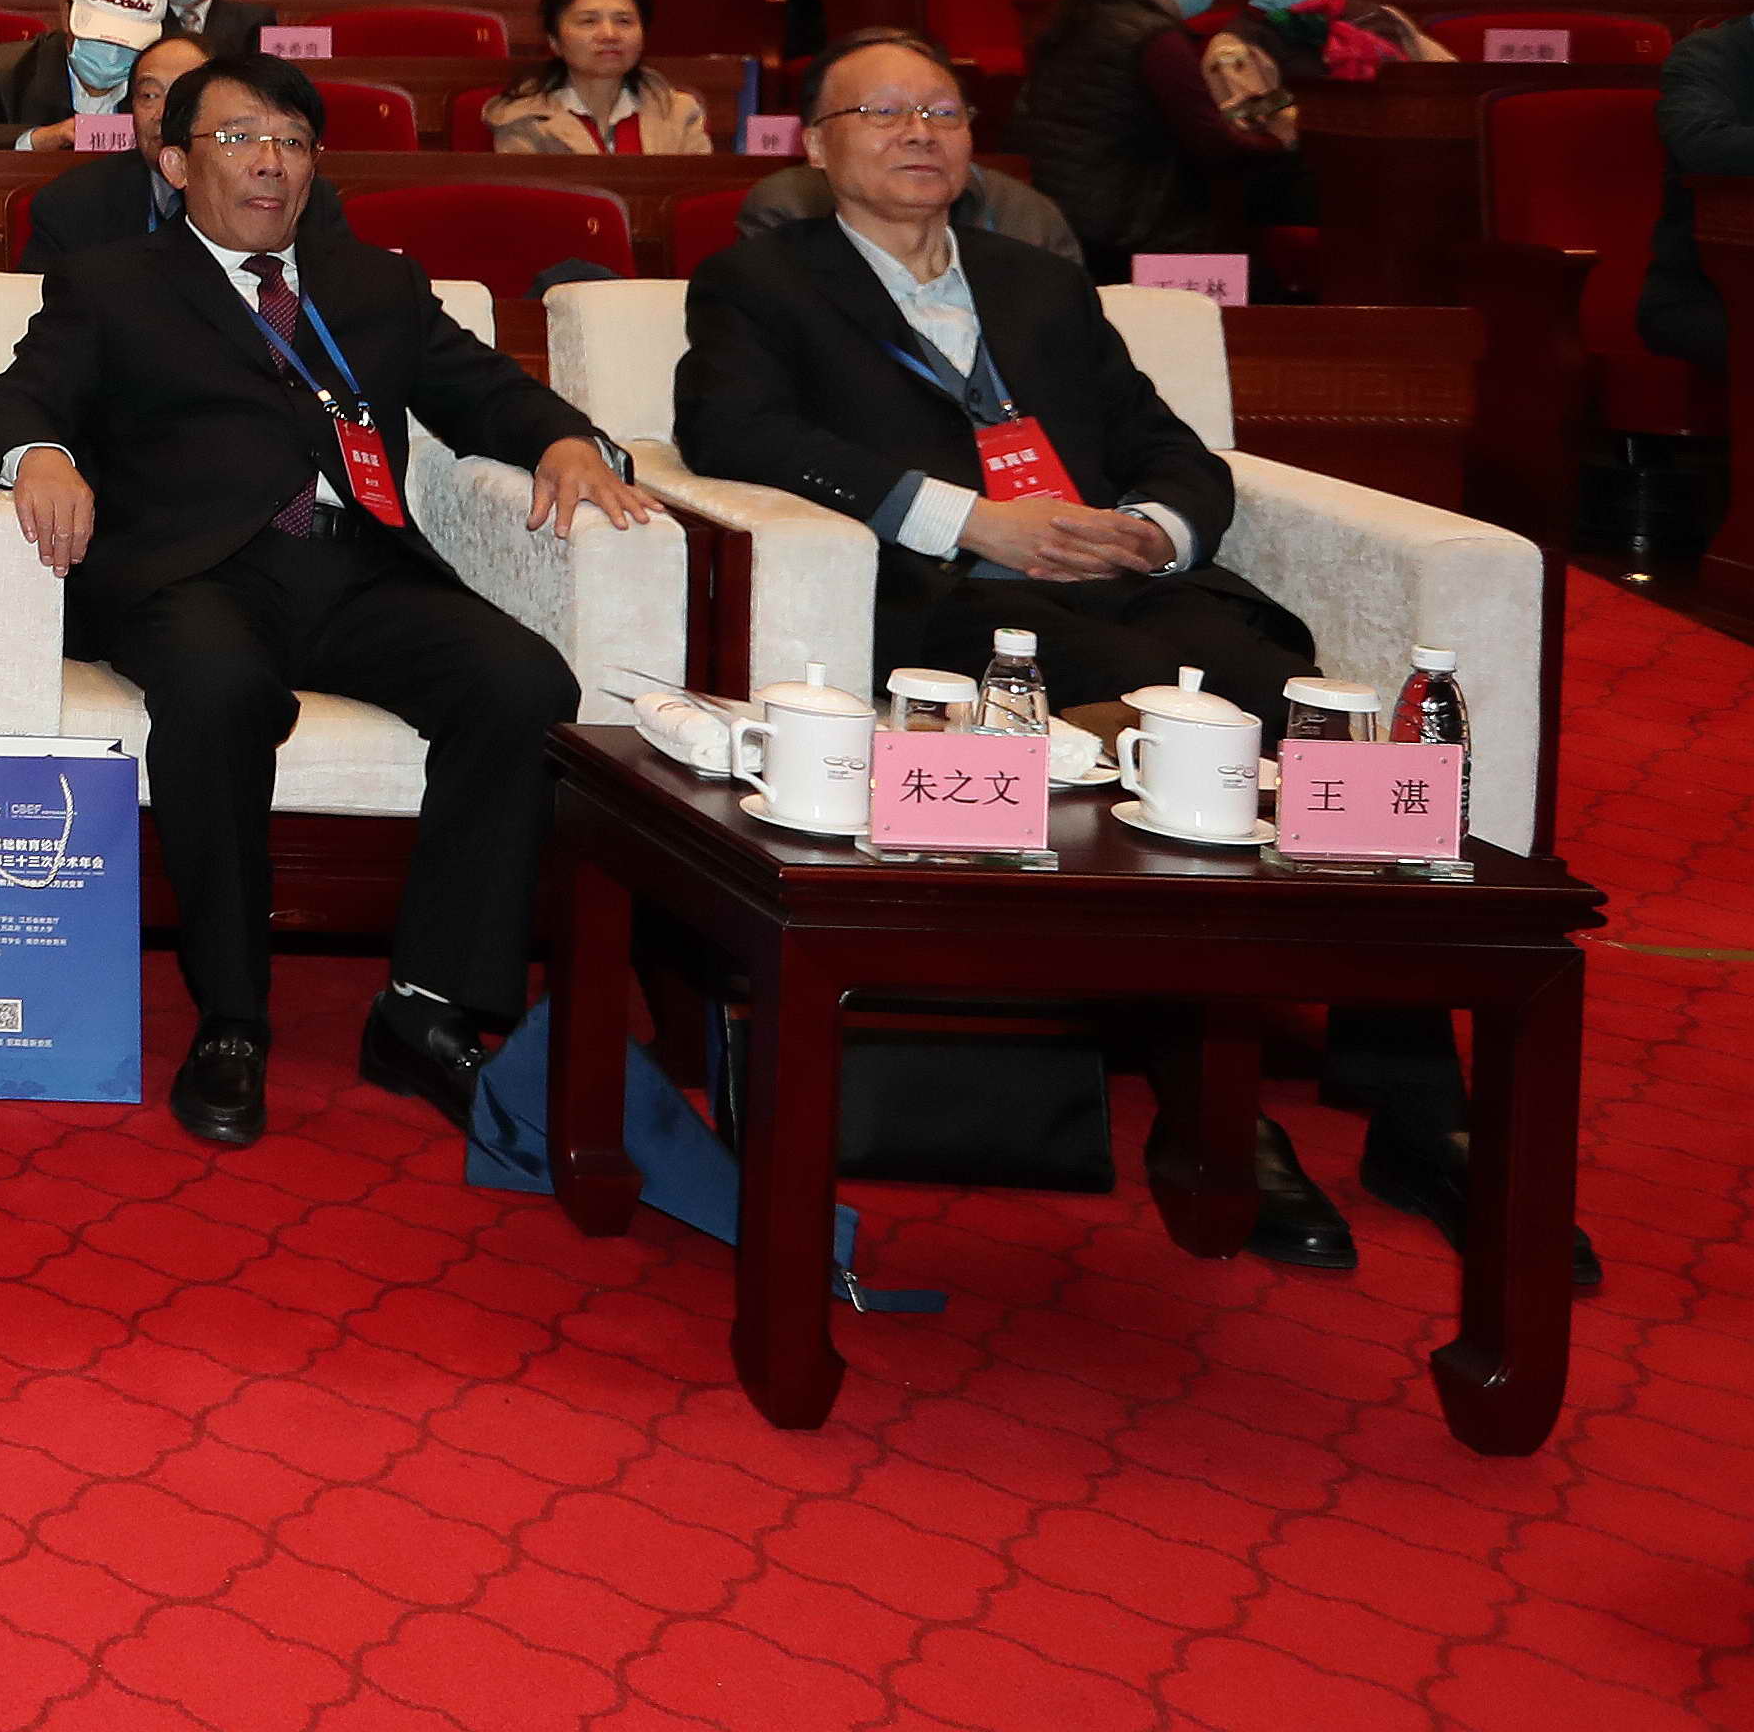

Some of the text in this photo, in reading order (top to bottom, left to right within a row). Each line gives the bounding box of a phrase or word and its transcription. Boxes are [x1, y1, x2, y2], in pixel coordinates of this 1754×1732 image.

[379, 103, 389, 118] 9
[587, 217, 598, 235] 9
[900, 768, 1021, 806] 朱之文
